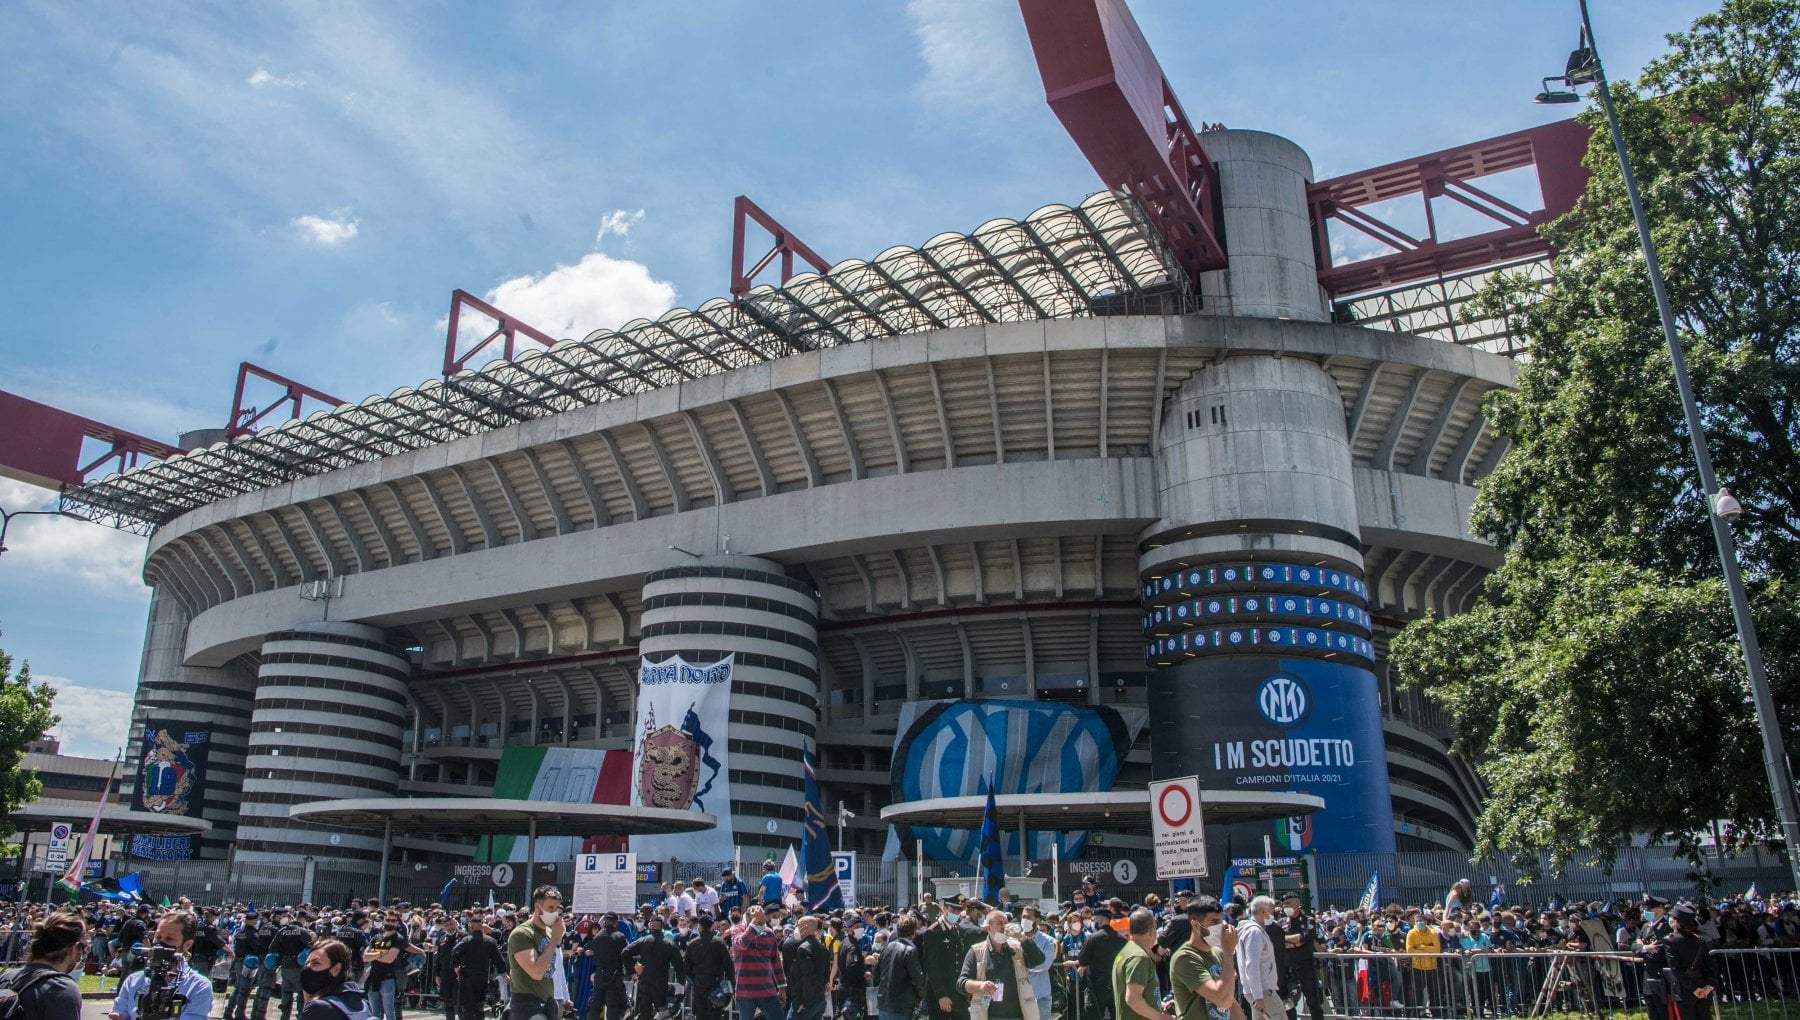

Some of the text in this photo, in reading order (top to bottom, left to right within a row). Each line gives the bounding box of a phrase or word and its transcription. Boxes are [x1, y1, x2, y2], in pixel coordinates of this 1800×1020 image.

[680, 663, 731, 684] NORD
[1214, 738, 1354, 770] I M SCUDETTO
[148, 766, 177, 796] 19
[1236, 774, 1341, 785] CAMPIONI D'ITALIA 20/21
[1172, 830, 1186, 838] giorni
[155, 836, 190, 850] LIBERI
[1155, 839, 1190, 847] manifestazioni
[587, 856, 595, 870] P
[617, 856, 625, 869] P
[835, 858, 849, 876] P
[1069, 862, 1111, 873] INGRESSO
[1232, 858, 1267, 867] NGRESSO
[454, 865, 491, 876] INGRESSO
[499, 866, 507, 884] 2
[1121, 863, 1129, 880] 3
